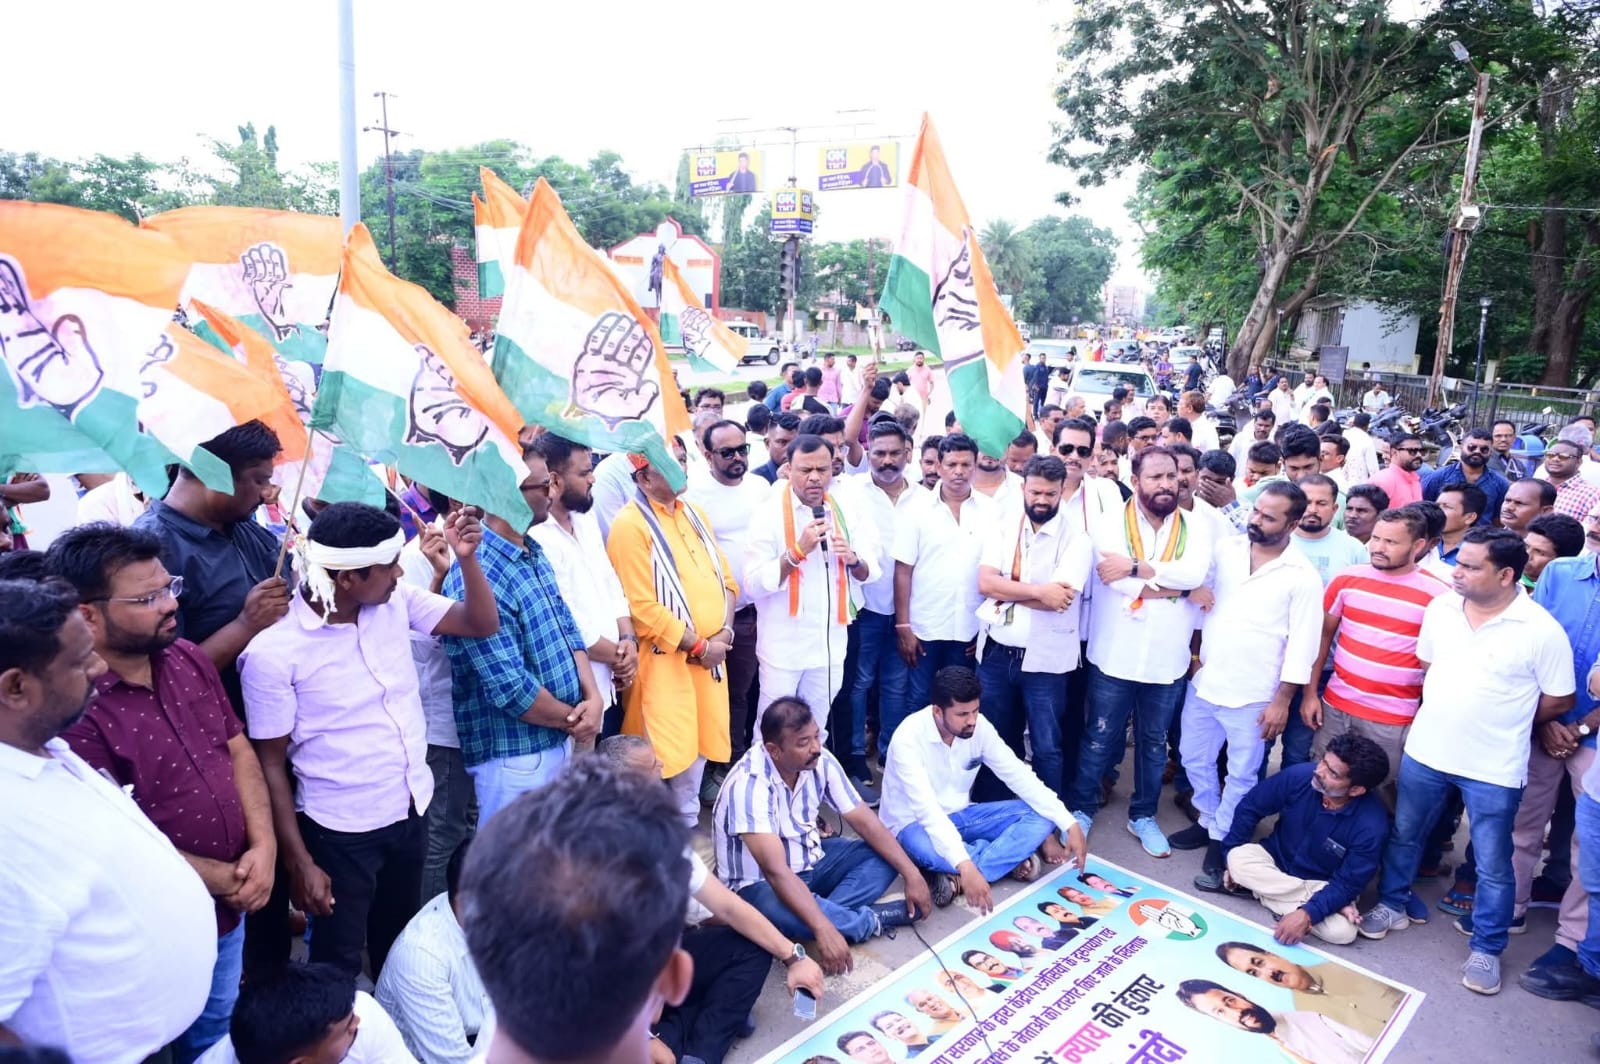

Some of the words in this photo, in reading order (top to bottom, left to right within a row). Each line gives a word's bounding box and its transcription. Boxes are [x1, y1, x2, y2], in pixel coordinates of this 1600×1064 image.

[778, 193, 796, 203] GK
[1113, 936, 1148, 959] खिलाफ
[1091, 960, 1117, 978] जाने
[1104, 955, 1123, 965] के
[989, 1005, 1016, 1025] द्वारा
[1004, 986, 1040, 1008] केंद्रीय
[1059, 956, 1077, 966] के
[1099, 926, 1117, 939] एवं
[1073, 974, 1100, 991] किए
[1052, 987, 1085, 1010] टारगेट
[1110, 973, 1165, 1015] हुंकार
[1042, 1005, 1062, 1020] को
[1091, 1002, 1131, 1028] की
[998, 1039, 1020, 1052] के
[1053, 1021, 1111, 1064] न्याय
